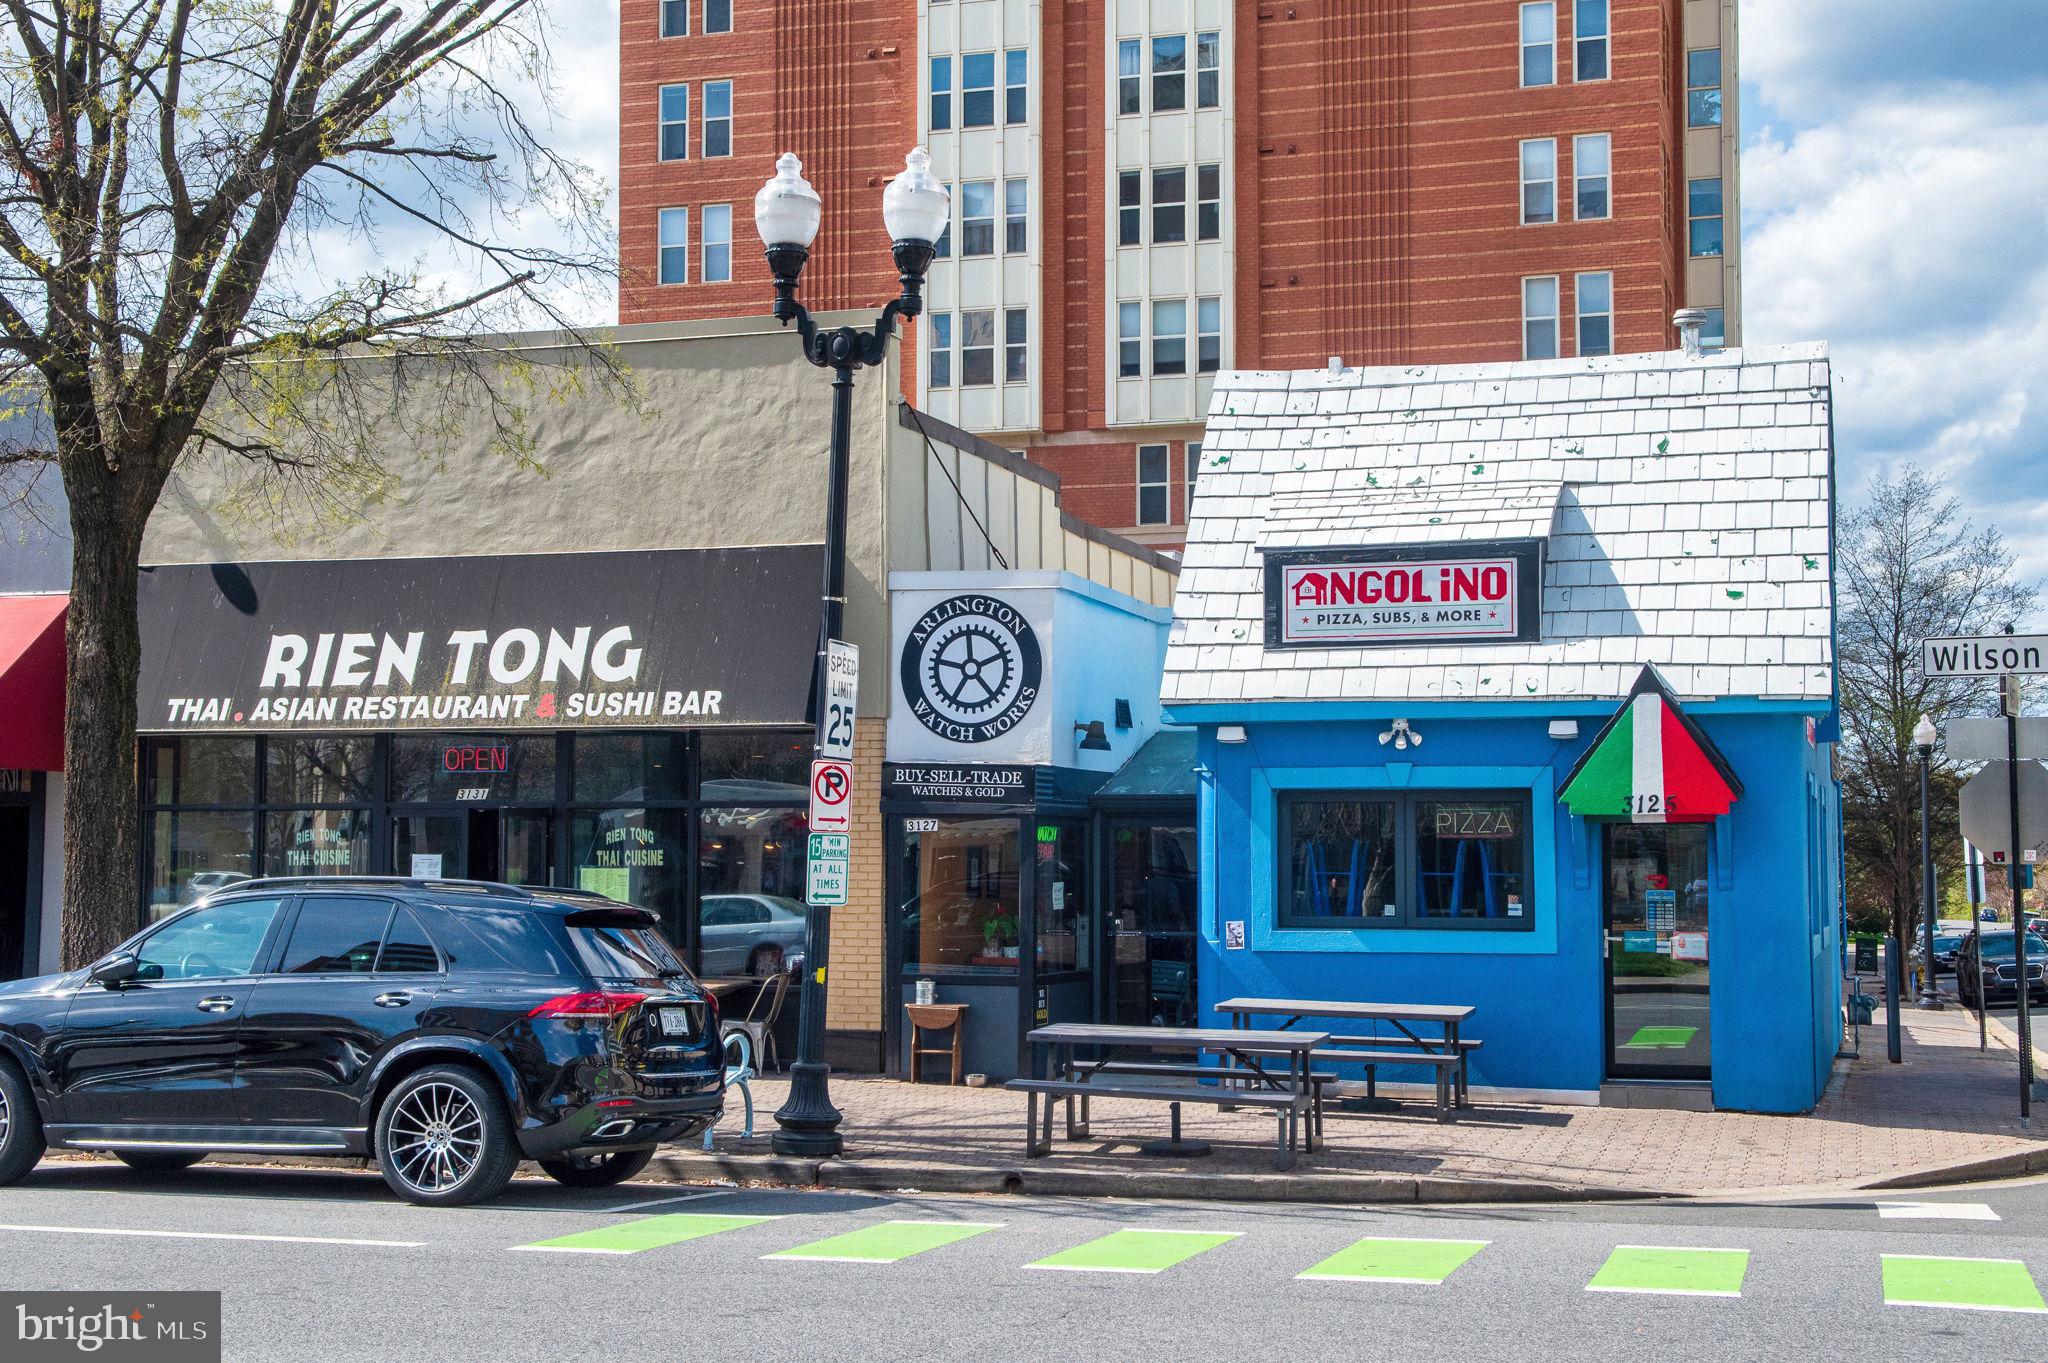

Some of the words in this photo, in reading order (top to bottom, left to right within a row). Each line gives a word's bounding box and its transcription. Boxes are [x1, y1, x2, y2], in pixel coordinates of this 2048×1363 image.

[913, 598, 1027, 645] ARLINGTON
[1317, 612, 1367, 626] PIZZA,
[1372, 611, 1416, 625] SUBS,
[1422, 612, 1430, 622] &
[1436, 610, 1481, 621] MORE
[259, 631, 424, 688] RIEN
[447, 625, 643, 684] TONG
[830, 655, 857, 676] SPEED
[1932, 643, 2040, 671] Wilson
[832, 680, 853, 699] LIMIT
[249, 697, 337, 721] ASIAN
[343, 694, 530, 720] RESTAURANT
[535, 693, 557, 717] &
[566, 692, 654, 718] SUSHI
[662, 690, 722, 716] BAR
[913, 698, 974, 741] WATCH
[981, 686, 1036, 739] WORKS
[827, 703, 853, 747] 25
[445, 747, 505, 771] OPEN
[895, 769, 1023, 784] BUY-SELL-TRADE
[458, 789, 487, 800] 3131
[912, 786, 963, 796] WATCHES
[965, 787, 972, 797] &
[975, 787, 1005, 797] GOLD
[1621, 794, 1677, 814] 3125
[908, 820, 937, 831] 3127
[1436, 812, 1513, 834] PIZZA
[296, 830, 315, 845] RIEN
[320, 828, 342, 843] TONG
[606, 830, 626, 845] RIEN
[630, 827, 654, 844] TONG
[828, 838, 841, 847] MIN
[811, 838, 821, 856] 15
[822, 849, 847, 858] PARKING
[287, 850, 310, 866] THAI
[313, 850, 350, 866] CUISINE
[597, 850, 620, 866] THAI
[624, 850, 664, 866] CUISINE
[813, 864, 823, 874] AT
[828, 864, 843, 875] ALL
[816, 879, 840, 889] TIMES
